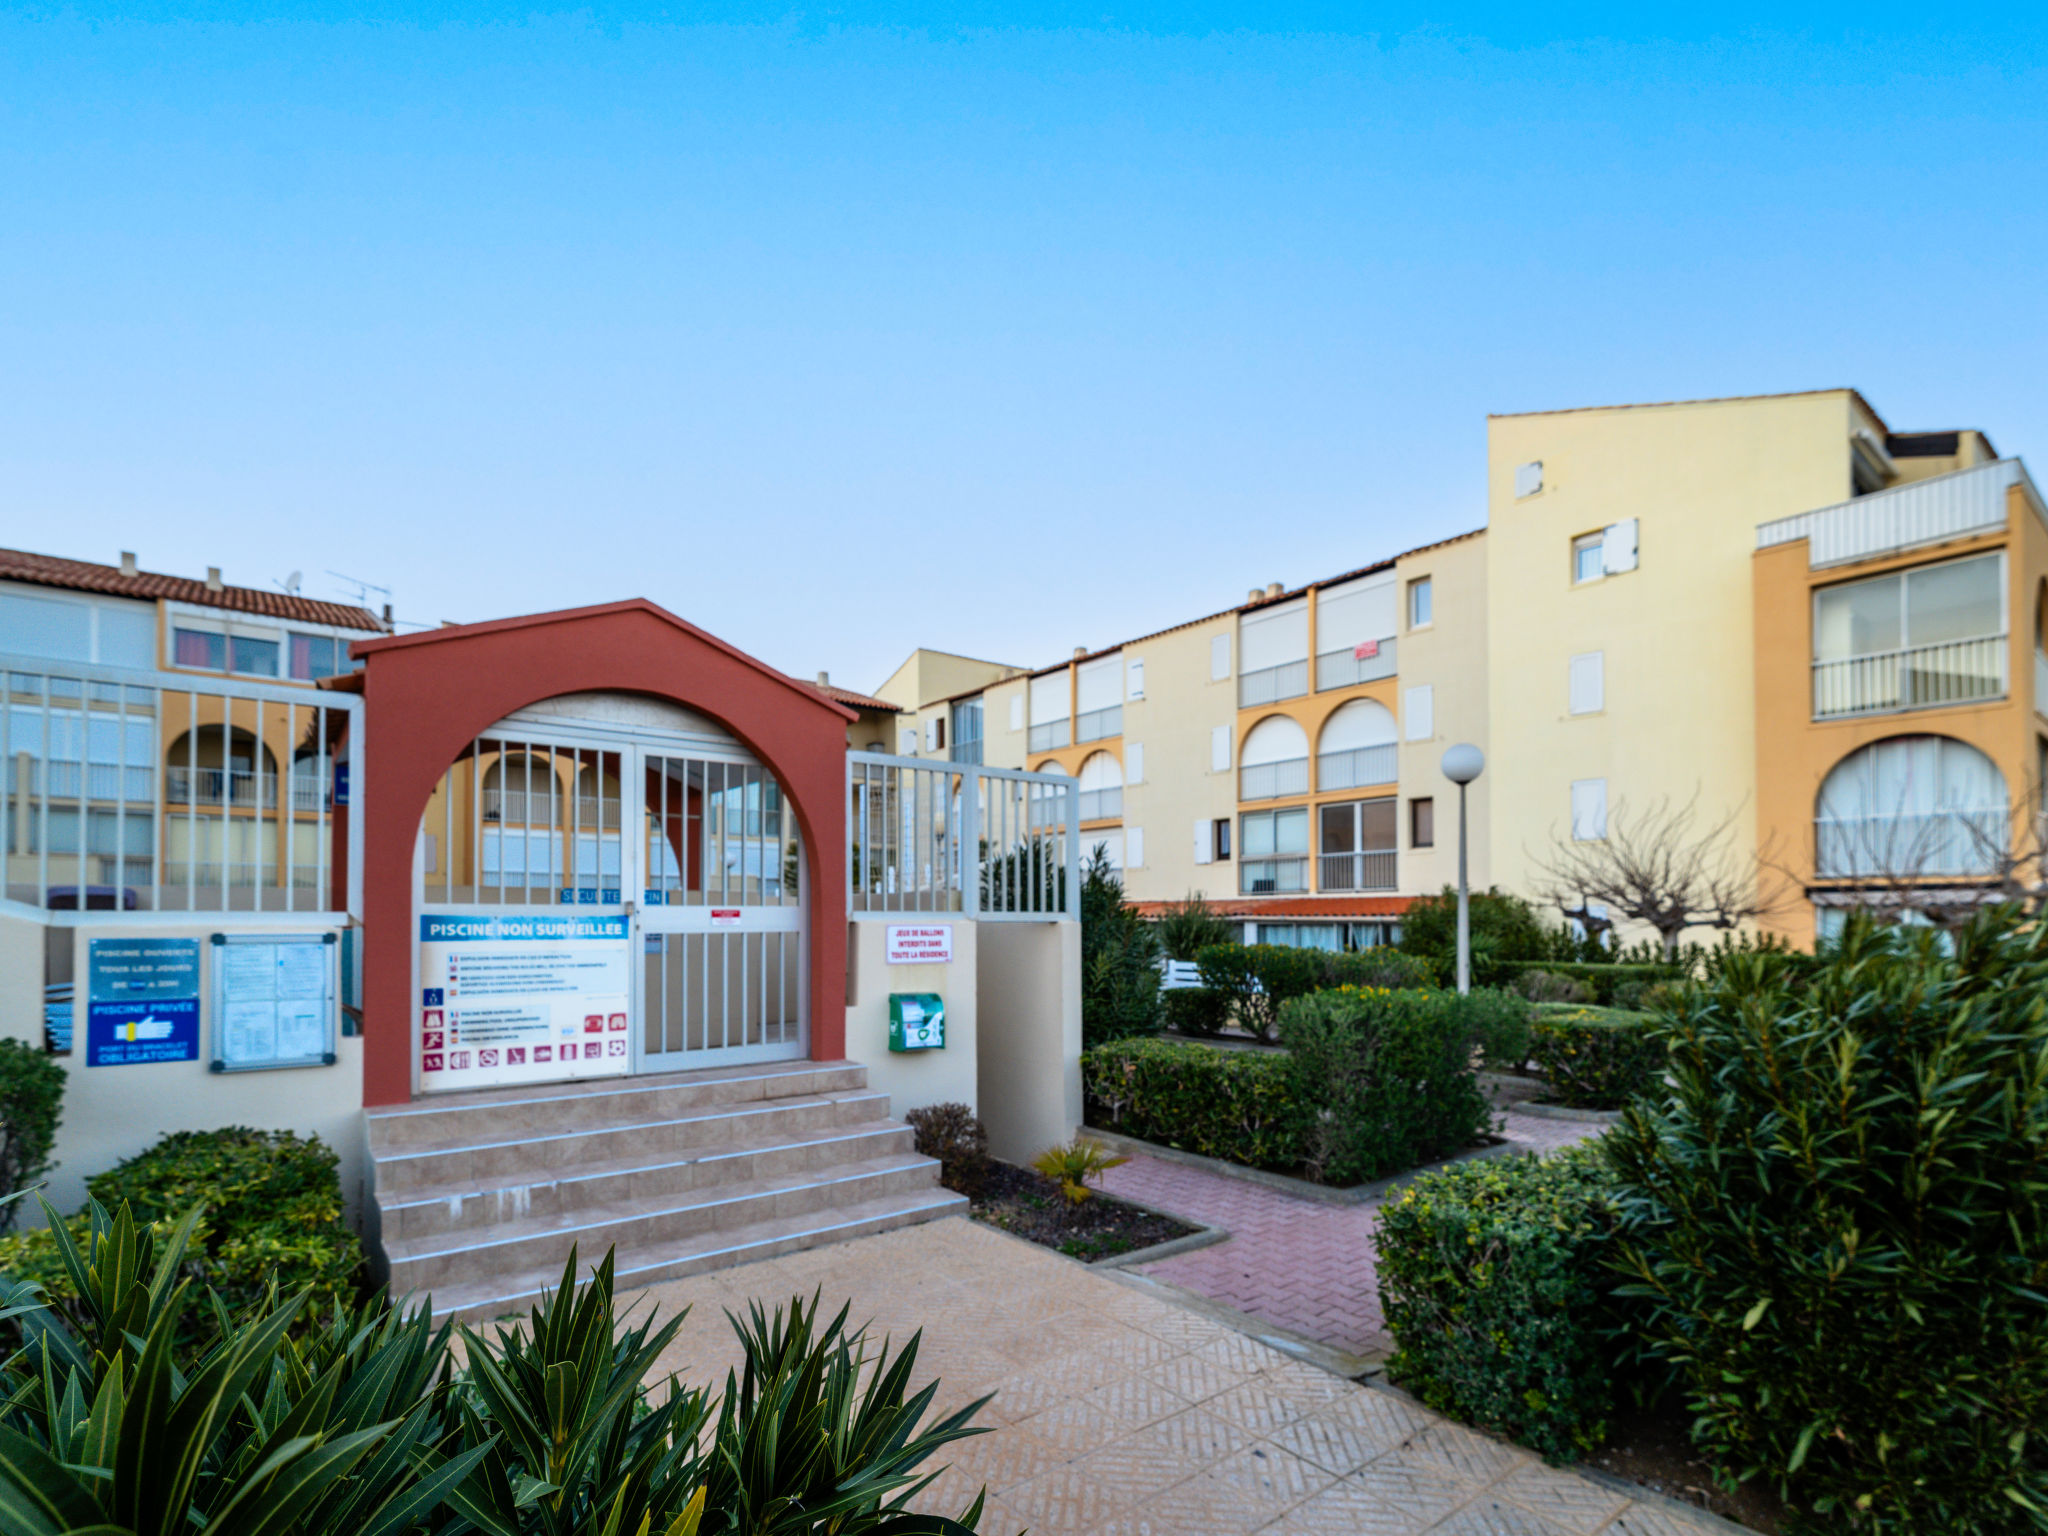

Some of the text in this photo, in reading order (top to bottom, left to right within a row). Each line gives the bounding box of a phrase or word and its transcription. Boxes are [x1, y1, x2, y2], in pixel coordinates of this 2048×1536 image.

[430, 922, 623, 937] PISCINE NON SURVEILLEE
[896, 929, 910, 937] JEUX
[920, 929, 944, 937] BALLONS
[898, 940, 926, 948] INTERDITS
[93, 1005, 146, 1015] PISCINE
[98, 1051, 187, 1063] OBLIGATOIRE
